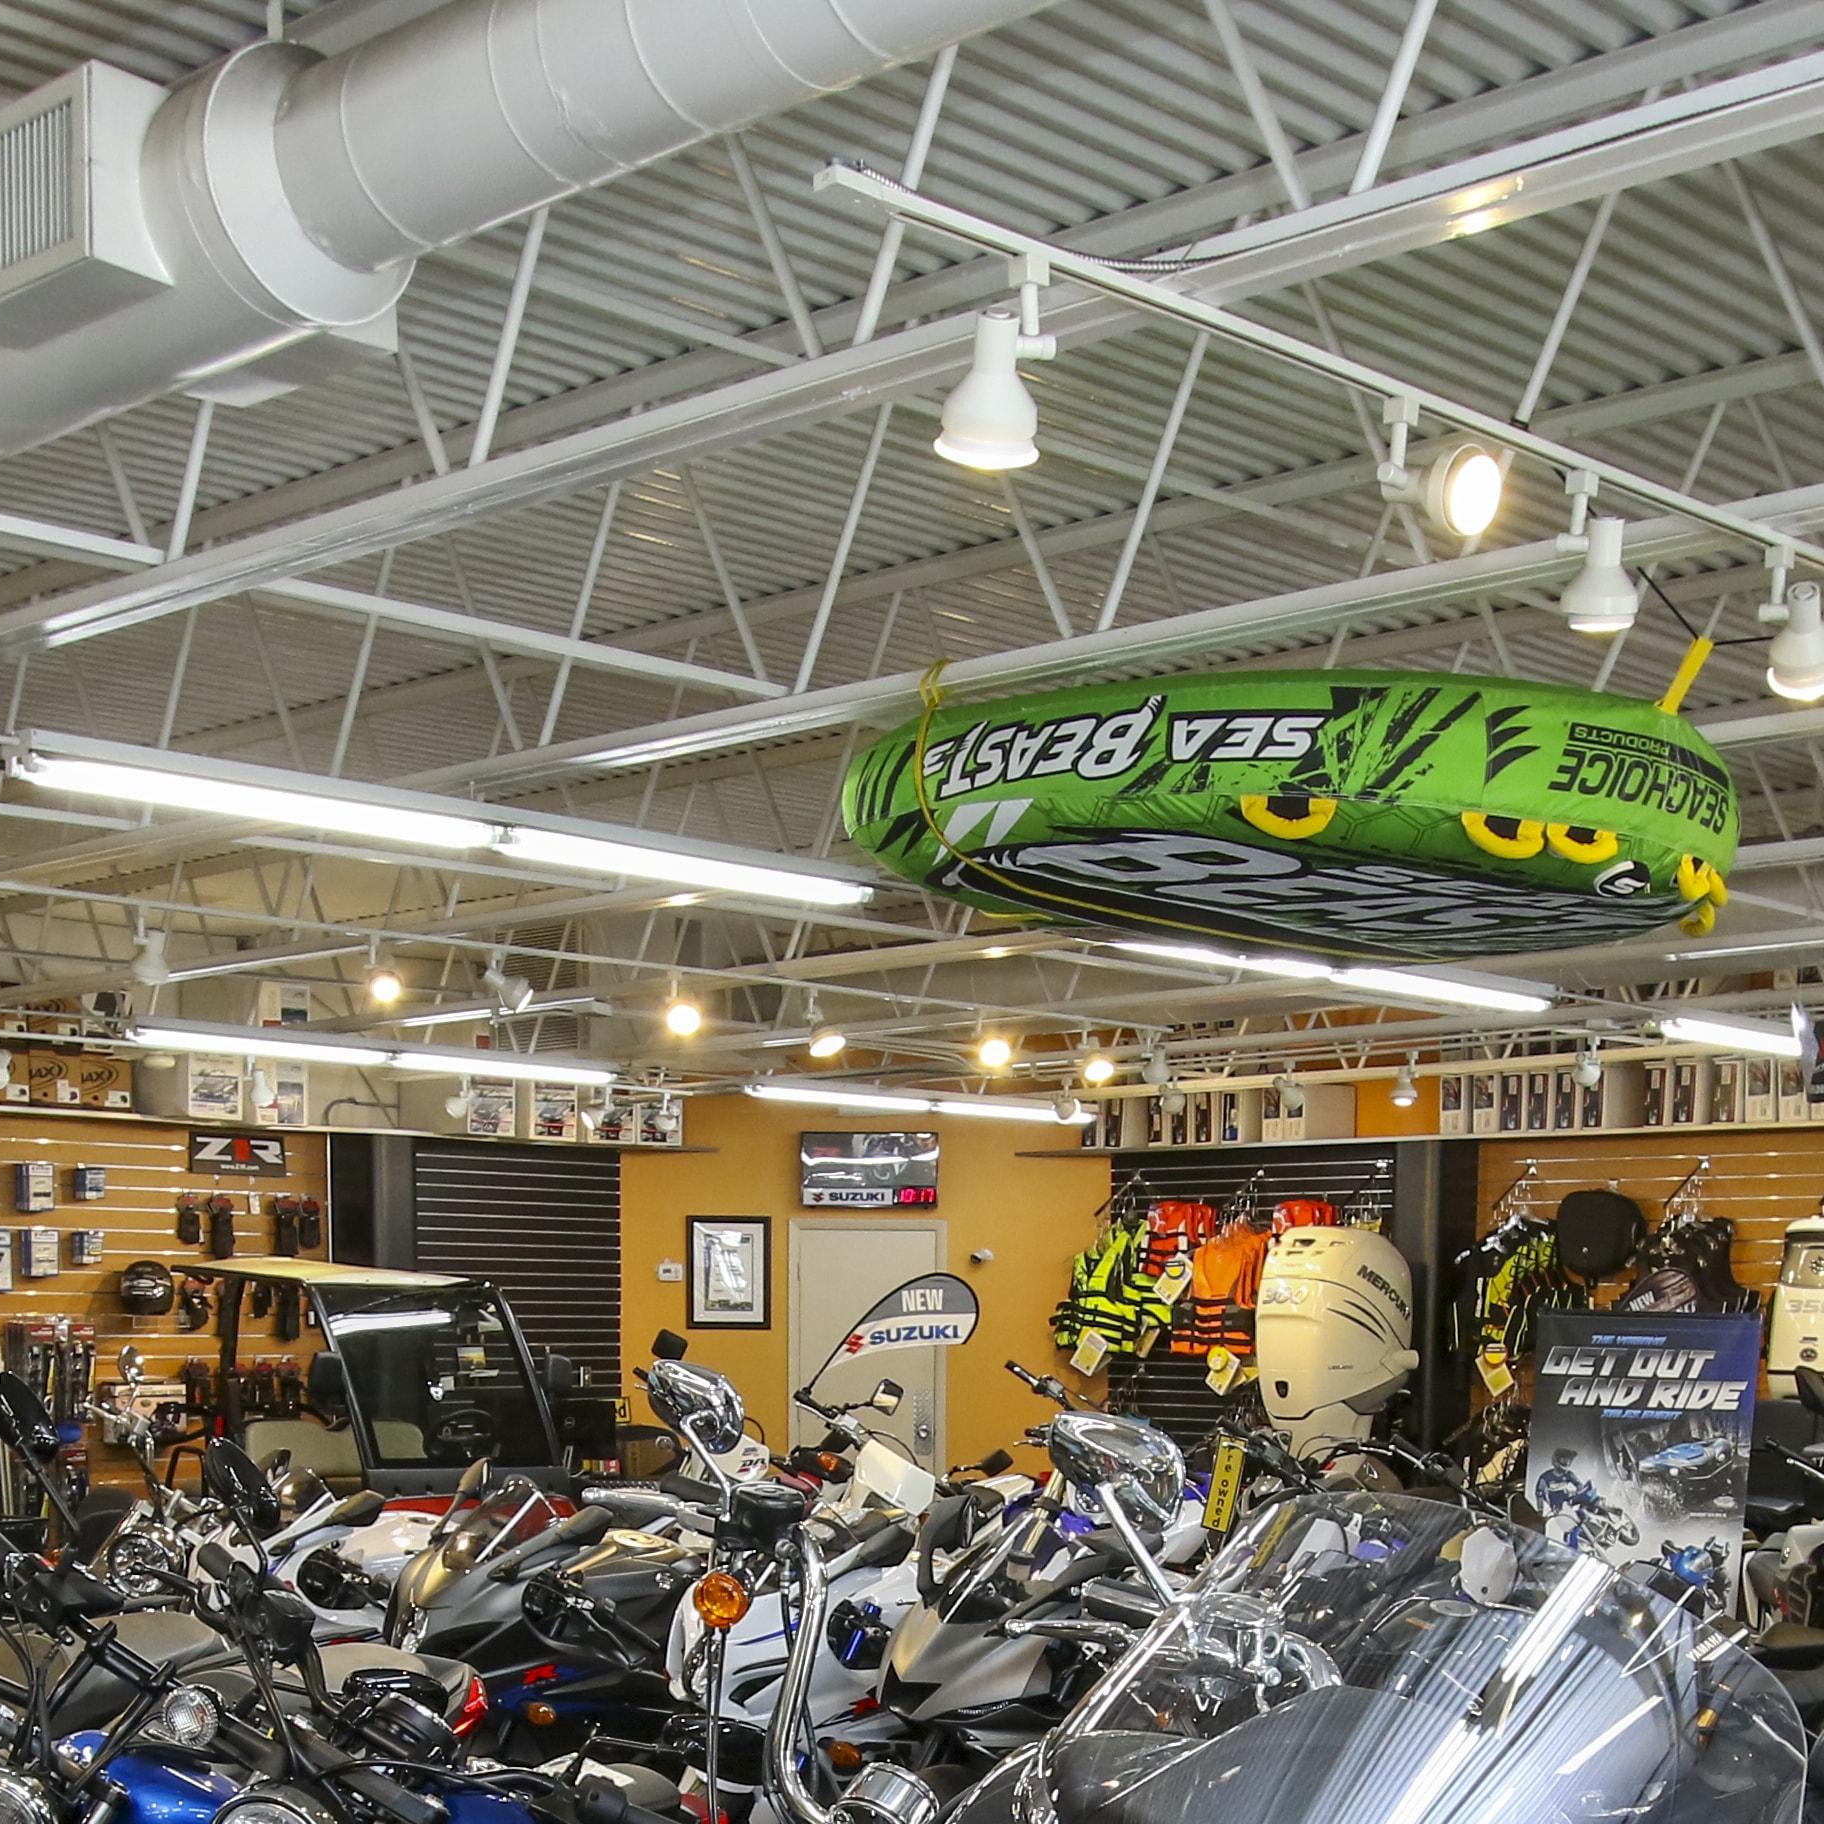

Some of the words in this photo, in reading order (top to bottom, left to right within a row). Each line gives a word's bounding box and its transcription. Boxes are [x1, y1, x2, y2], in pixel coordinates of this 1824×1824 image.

[1171, 714, 1325, 761] SEA
[1574, 725, 1672, 756] PRODUCTS
[1547, 747, 1731, 835] SEACHOICE
[828, 1191, 886, 1202] SUZUKI
[901, 1289, 944, 1313] NEW
[1628, 1290, 1656, 1312] NEW
[869, 1324, 960, 1346] SUZUKI
[1541, 1346, 1628, 1376] GET
[1627, 1349, 1717, 1379] OUT
[1557, 1377, 1647, 1407] AND
[1646, 1380, 1749, 1411] RIDE
[1211, 1480, 1229, 1528] owned
[1685, 1632, 1722, 1661] YAMAHA
